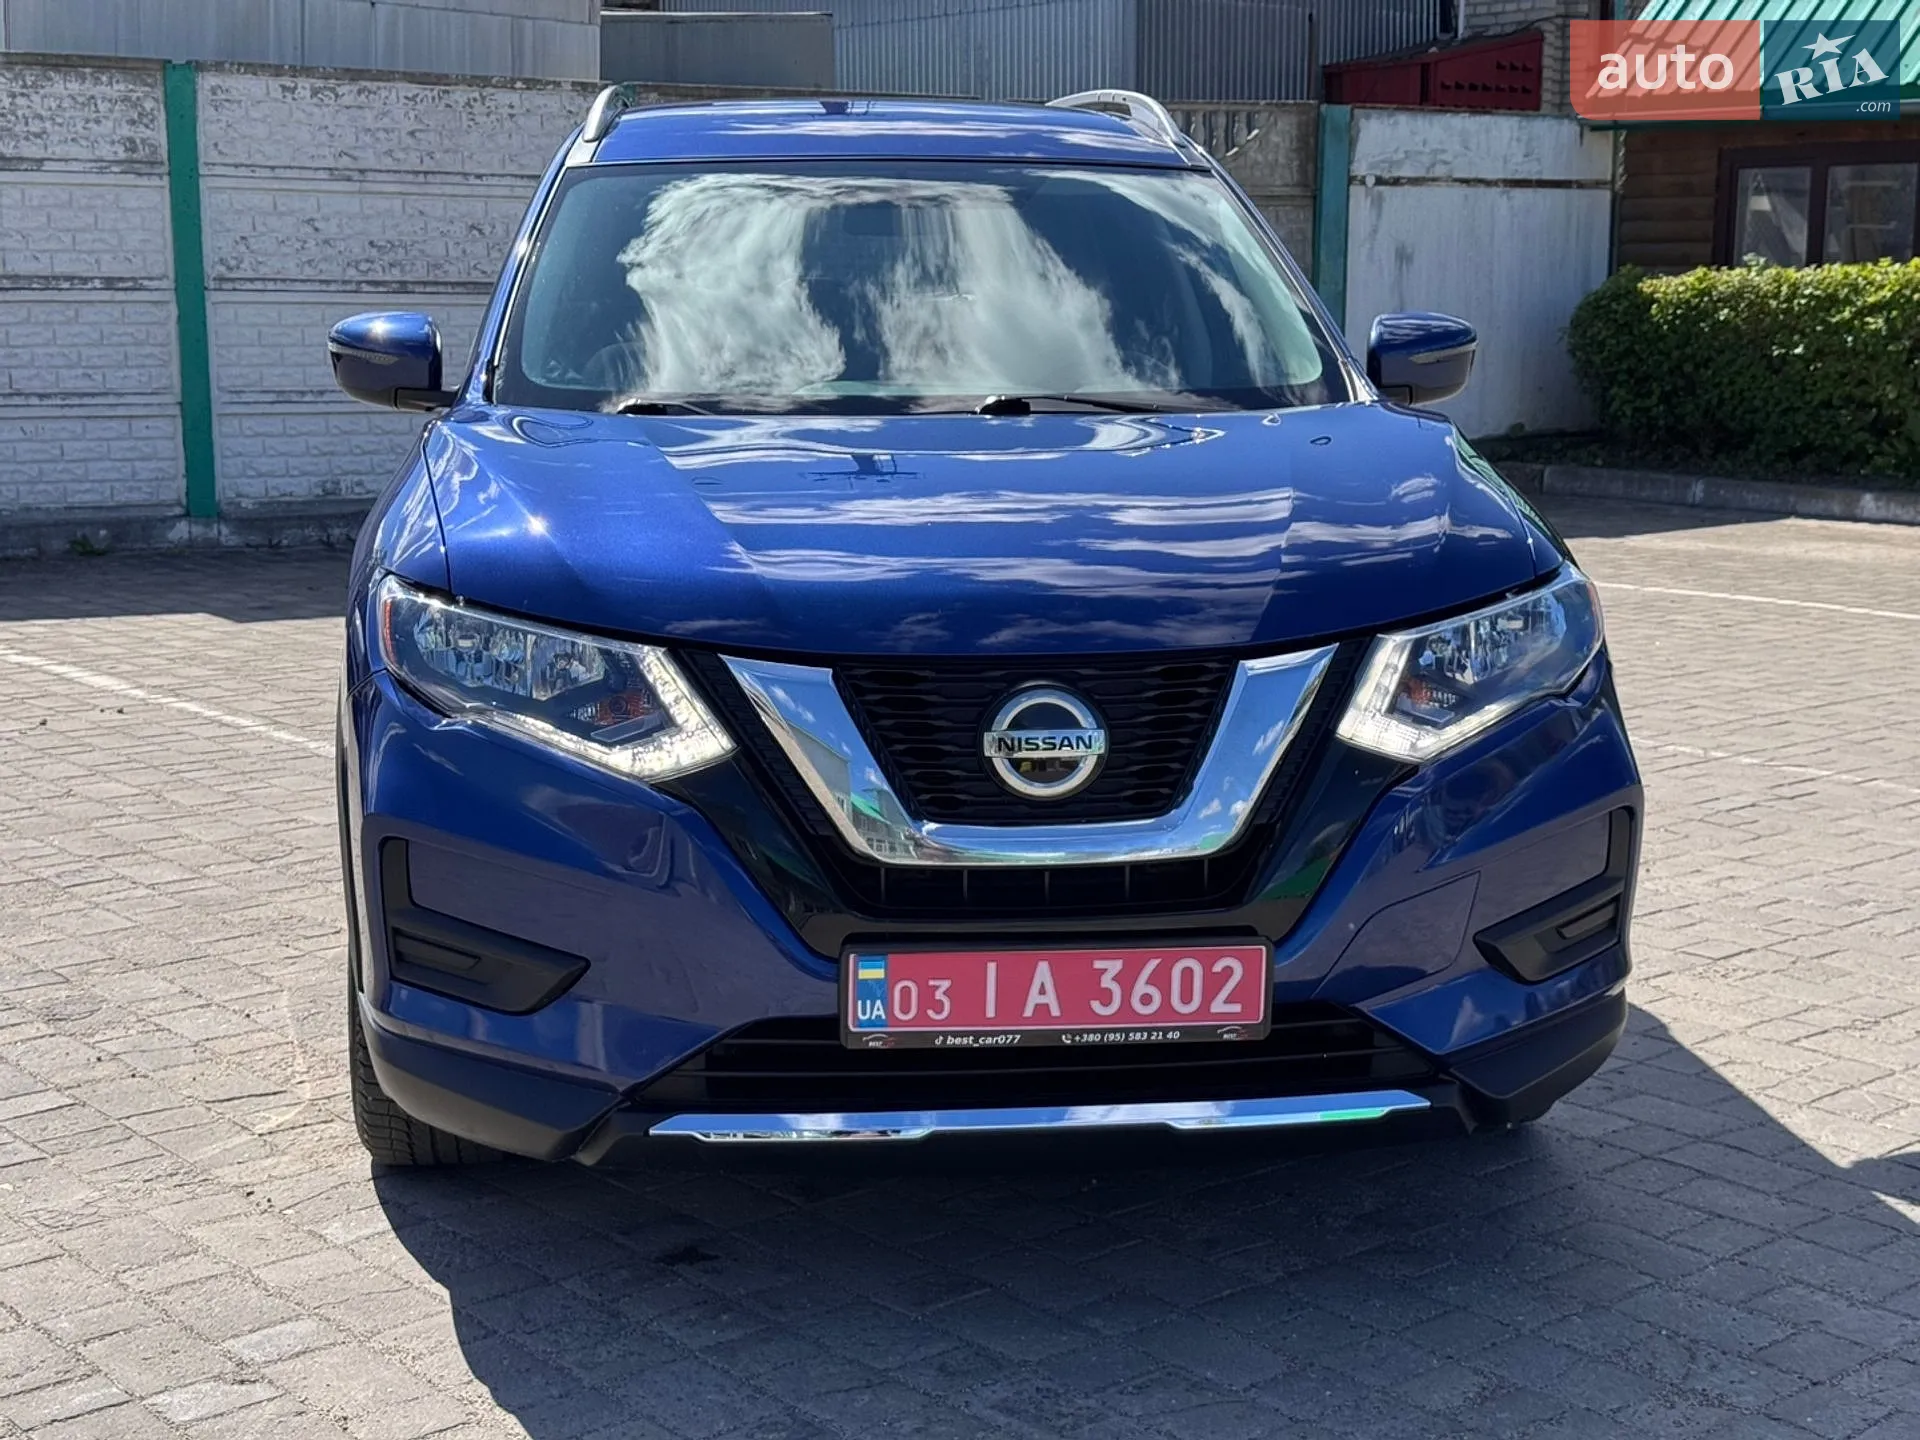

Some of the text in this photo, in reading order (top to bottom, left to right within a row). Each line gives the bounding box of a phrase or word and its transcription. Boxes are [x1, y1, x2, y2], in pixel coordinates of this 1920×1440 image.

[997, 734, 1093, 752] NISSAN
[892, 978, 953, 1022] 03
[1088, 955, 1243, 1017] 3602
[857, 999, 887, 1021] UA
[946, 1034, 1021, 1047] best_car077
[1074, 1032, 1102, 1043] +380
[1103, 1031, 1126, 1043] (95)
[1150, 1031, 1163, 1040] 21
[1166, 1030, 1180, 1040] 40
